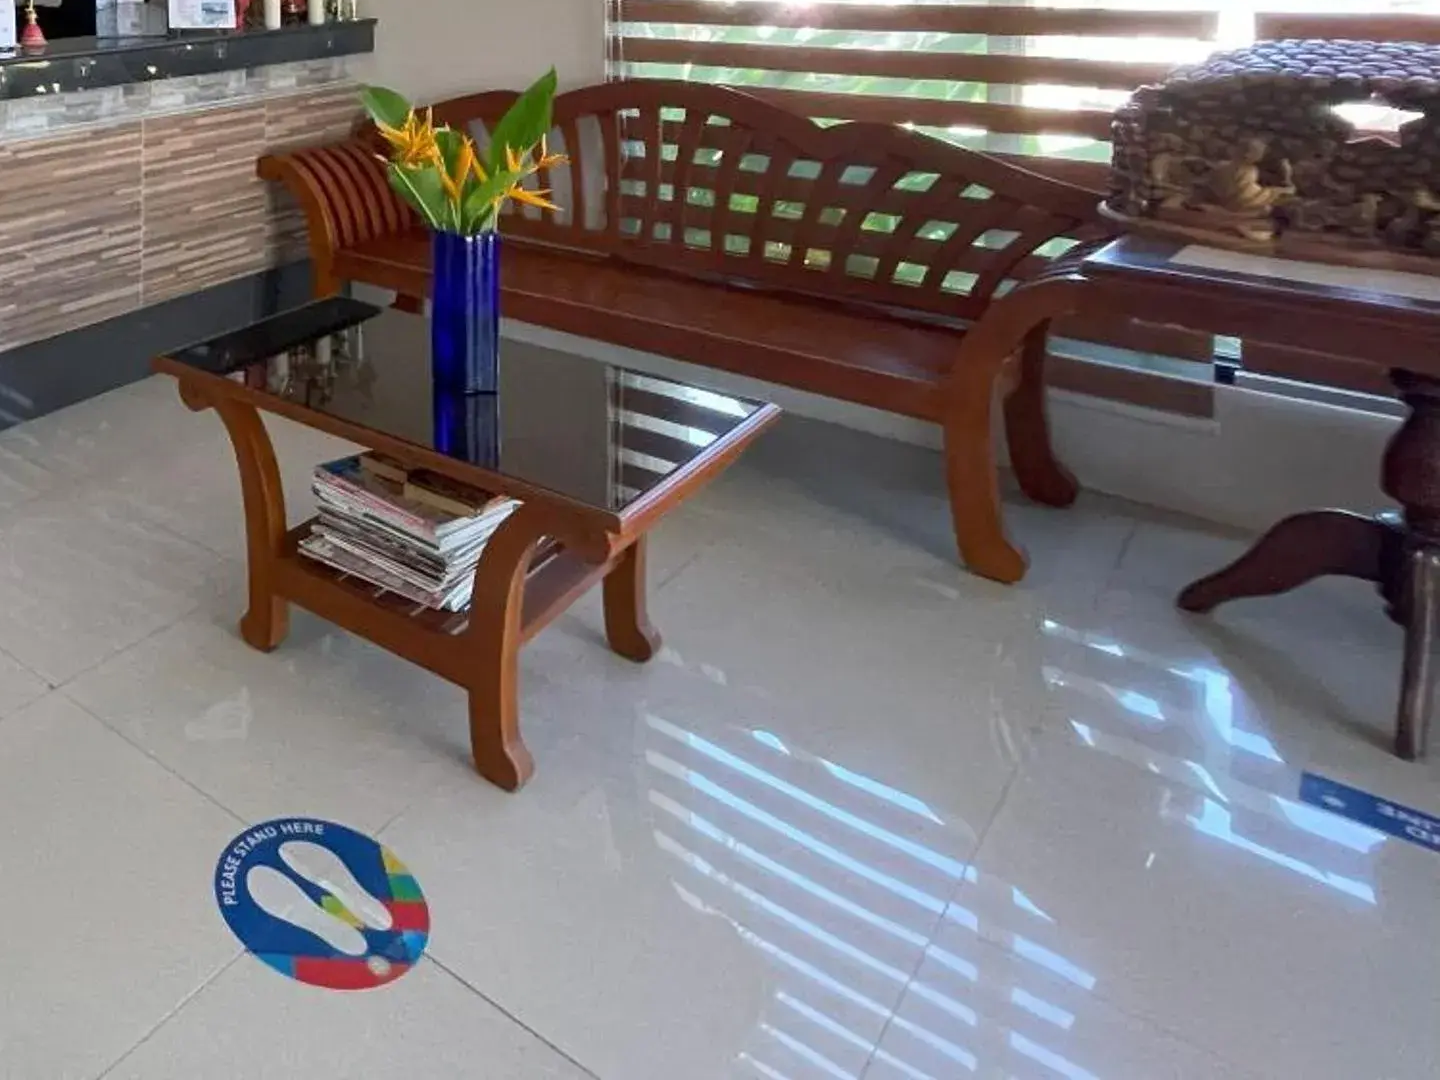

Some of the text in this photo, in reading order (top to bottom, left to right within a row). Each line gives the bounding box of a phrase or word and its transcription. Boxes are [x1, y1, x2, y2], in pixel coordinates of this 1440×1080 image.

[221, 822, 324, 906] PLEASE STAND HERE
